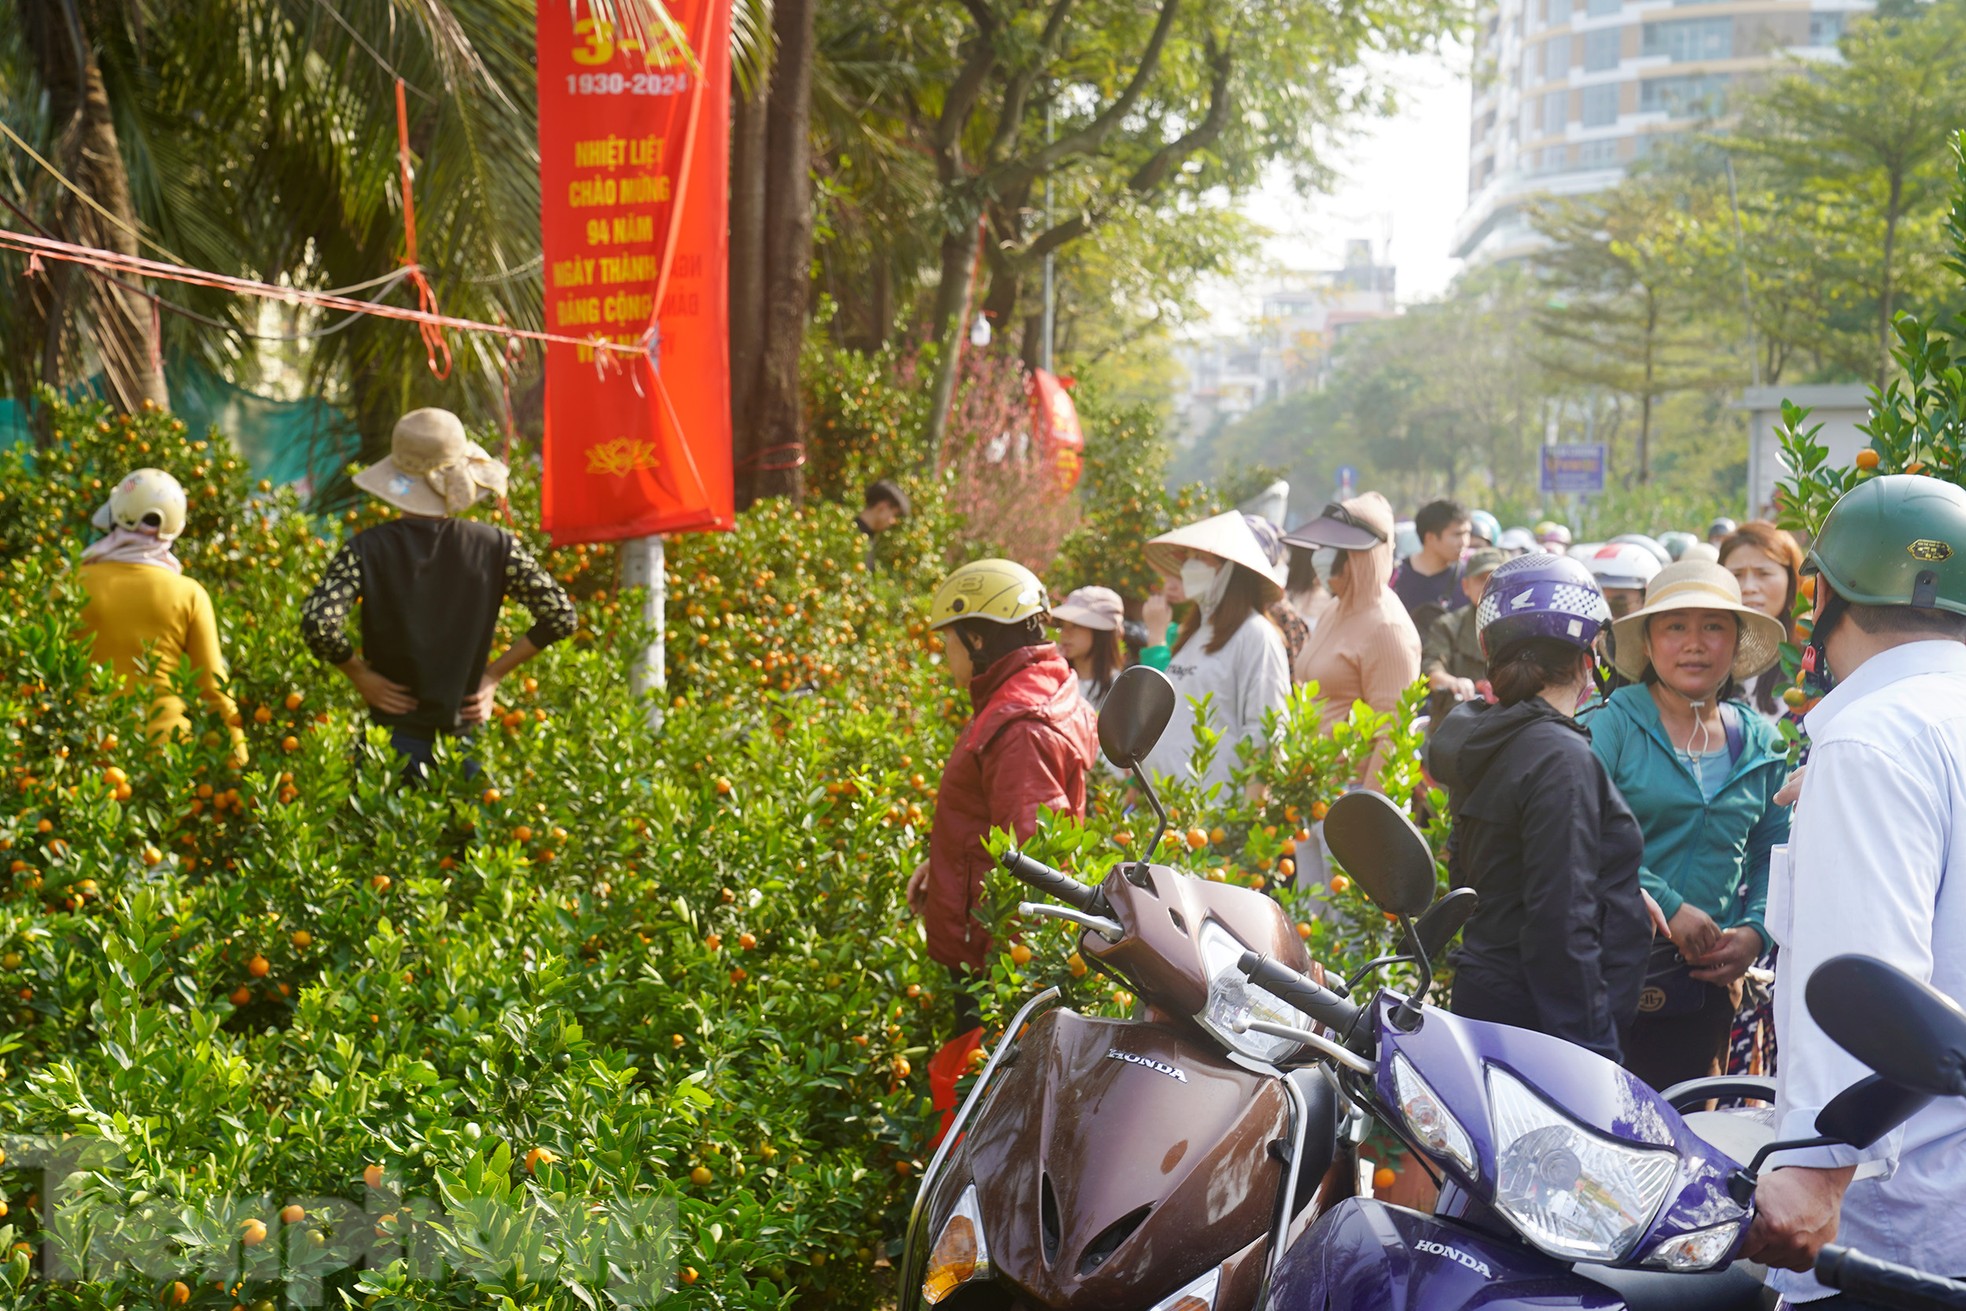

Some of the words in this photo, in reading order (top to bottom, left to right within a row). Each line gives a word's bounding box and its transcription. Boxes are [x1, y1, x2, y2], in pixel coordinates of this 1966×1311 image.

[571, 18, 688, 66] 3-2
[566, 73, 687, 96] 1930-2024
[574, 133, 627, 171] NHIỆT
[630, 133, 666, 170] LIỆT
[568, 174, 617, 208] CHÀO
[586, 218, 610, 246] 94
[613, 212, 653, 244] NĂM
[552, 253, 596, 288] NGÀY
[556, 291, 600, 327] ĐẢNG
[1107, 1048, 1188, 1084] HONDA
[1415, 1239, 1492, 1279] HONDA
